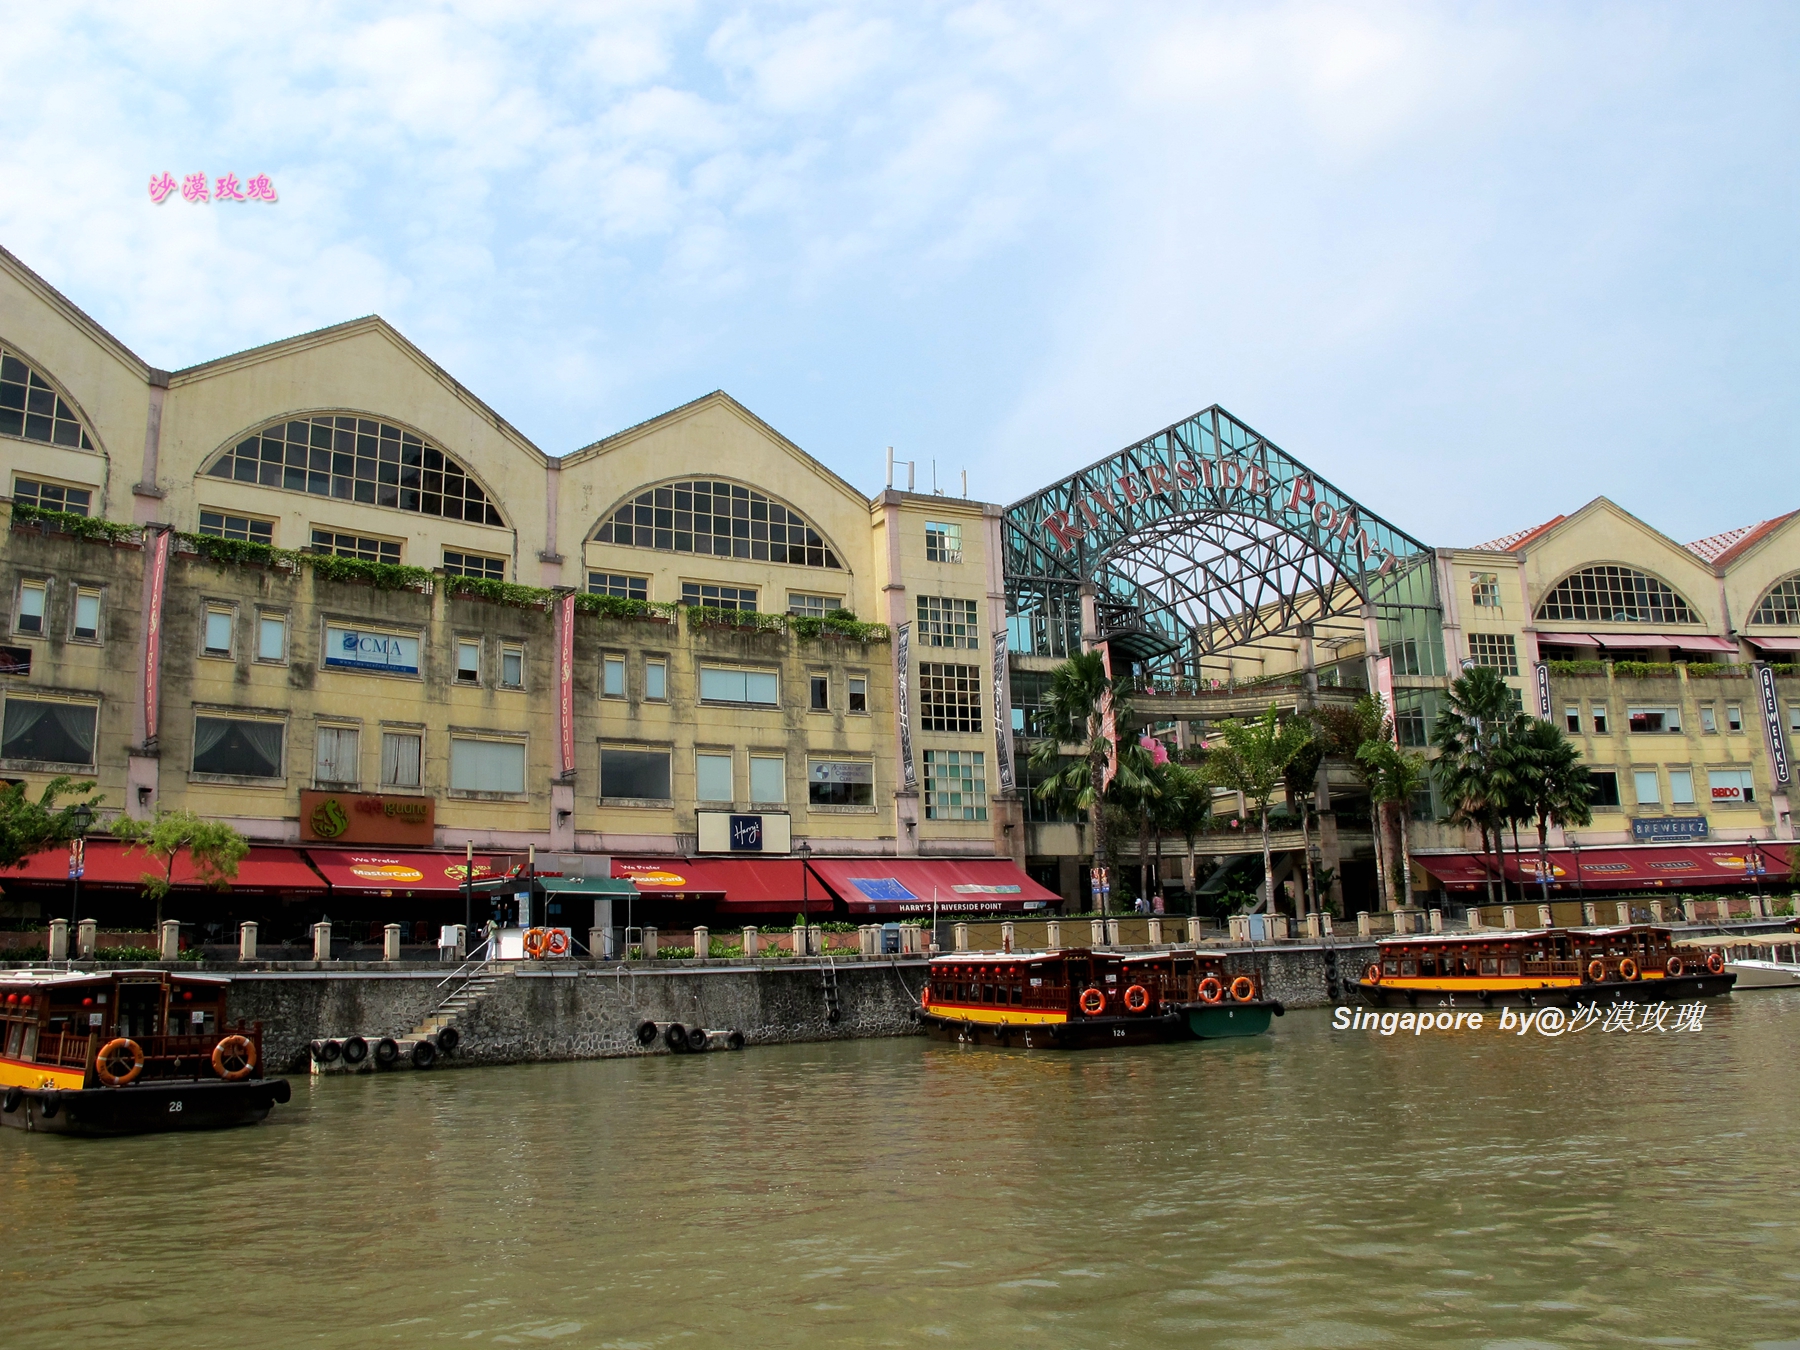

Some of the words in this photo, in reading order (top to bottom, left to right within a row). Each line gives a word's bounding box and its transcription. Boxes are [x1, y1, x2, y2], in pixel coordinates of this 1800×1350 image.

[1040, 459, 1271, 553] RIVERSIDE
[1284, 475, 1399, 577] POINT
[360, 637, 402, 655] CMA
[1763, 675, 1786, 775] BREWERKZ
[1712, 788, 1740, 797] BBDO
[734, 821, 760, 845] Harry's
[1636, 822, 1705, 834] BREWERKZ
[353, 869, 420, 877] MasterCard
[899, 904, 932, 912] HARRY'S
[941, 903, 979, 911] RIVERSIDE
[980, 903, 1002, 911] POINT
[1113, 1029, 1126, 1037] 126
[169, 1101, 183, 1112] 28
